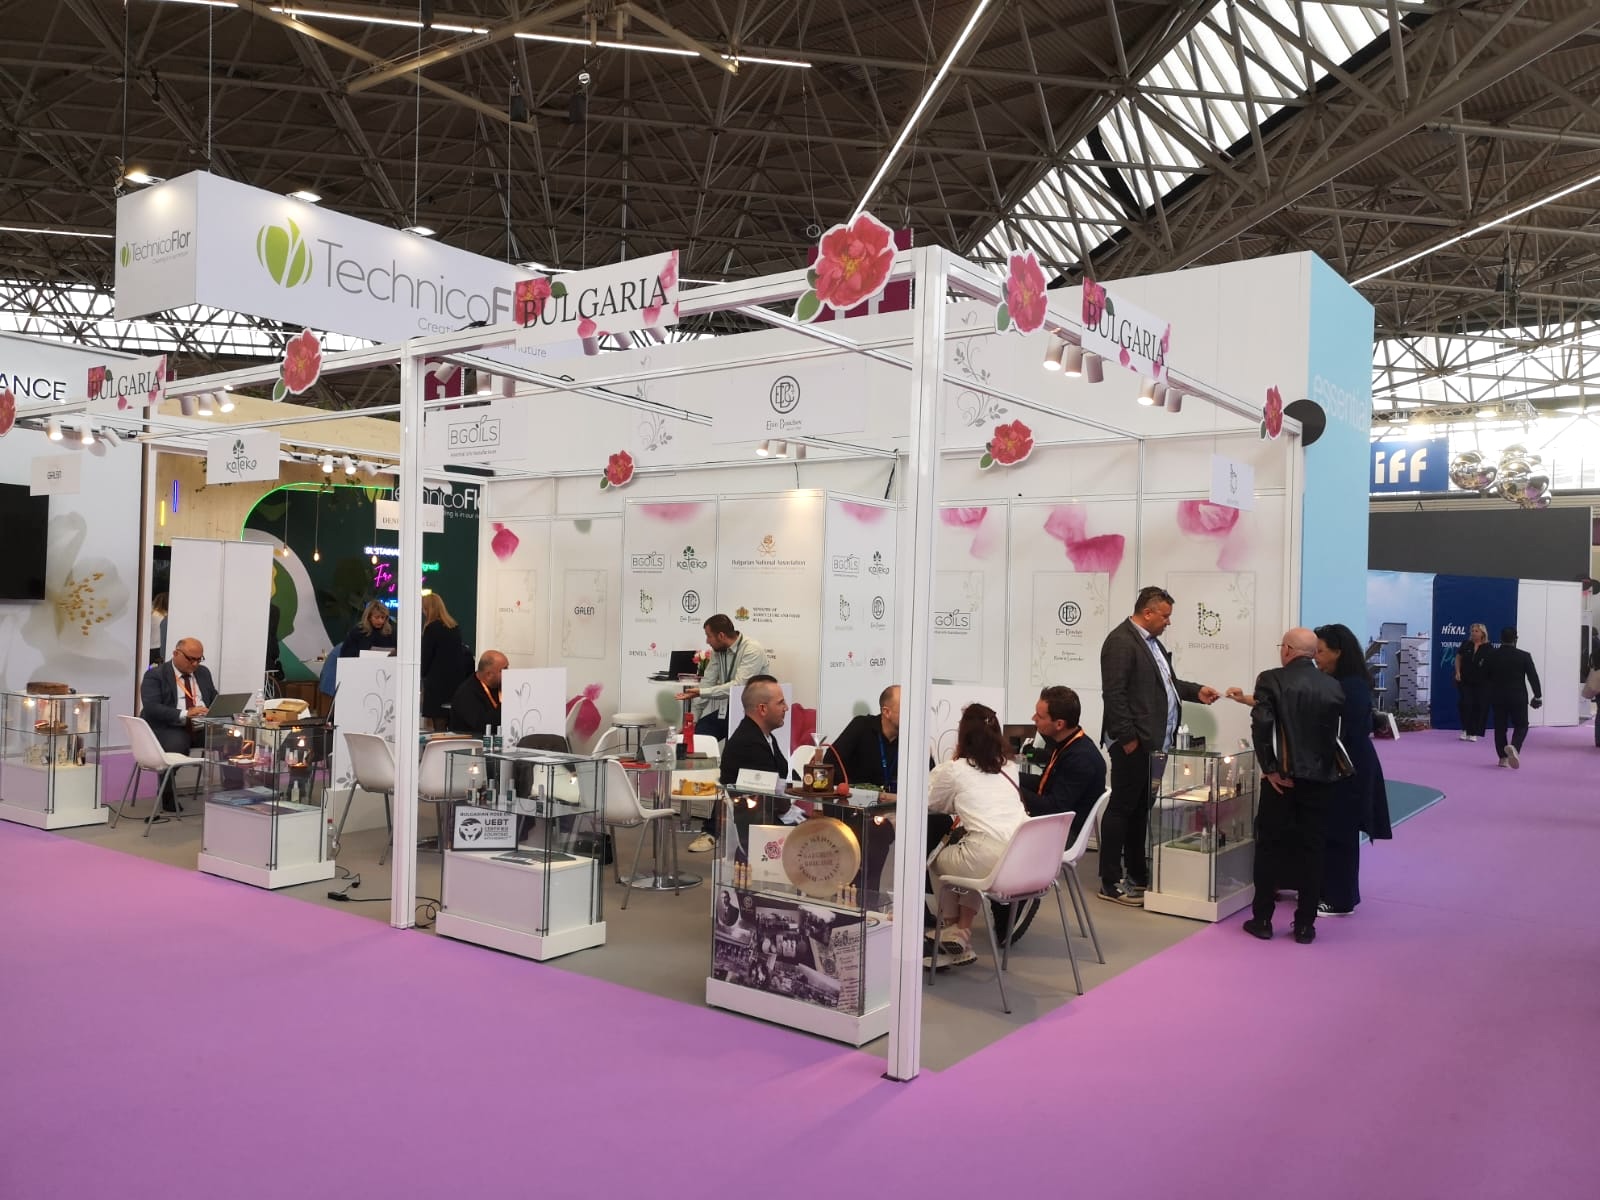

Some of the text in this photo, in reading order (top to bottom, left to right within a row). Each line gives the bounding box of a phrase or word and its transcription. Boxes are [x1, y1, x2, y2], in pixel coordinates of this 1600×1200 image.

[131, 230, 191, 262] TechnicoFlor
[523, 274, 670, 329] BULGARIA
[1087, 301, 1165, 366] BULGARIA
[91, 370, 161, 401] BULGARIA
[1375, 447, 1428, 484] iff
[1188, 642, 1230, 650] BRIGHTERS
